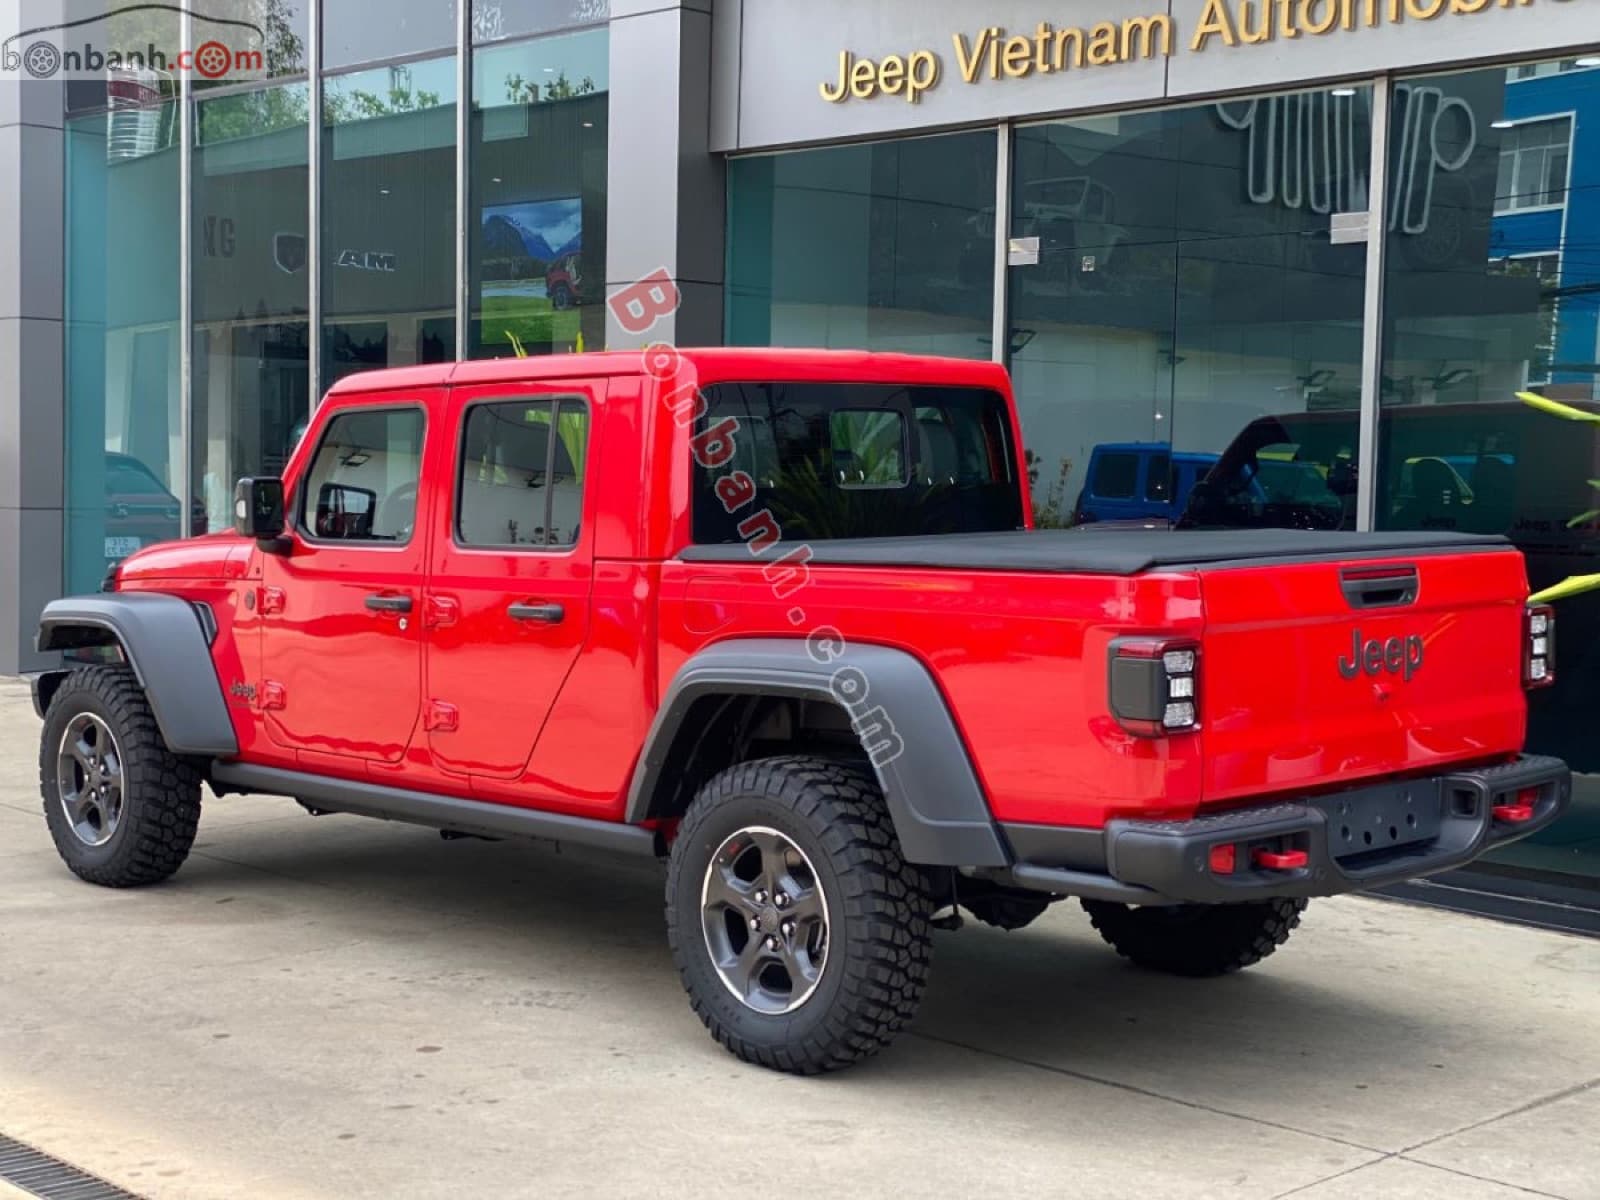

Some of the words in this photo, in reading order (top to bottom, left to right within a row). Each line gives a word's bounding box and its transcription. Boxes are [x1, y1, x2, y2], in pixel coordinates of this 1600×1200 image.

[819, 49, 942, 104] Jeep
[952, 12, 1174, 84] Vietnam
[1190, 0, 1582, 52] Automo
[1337, 627, 1424, 682] Jeep
